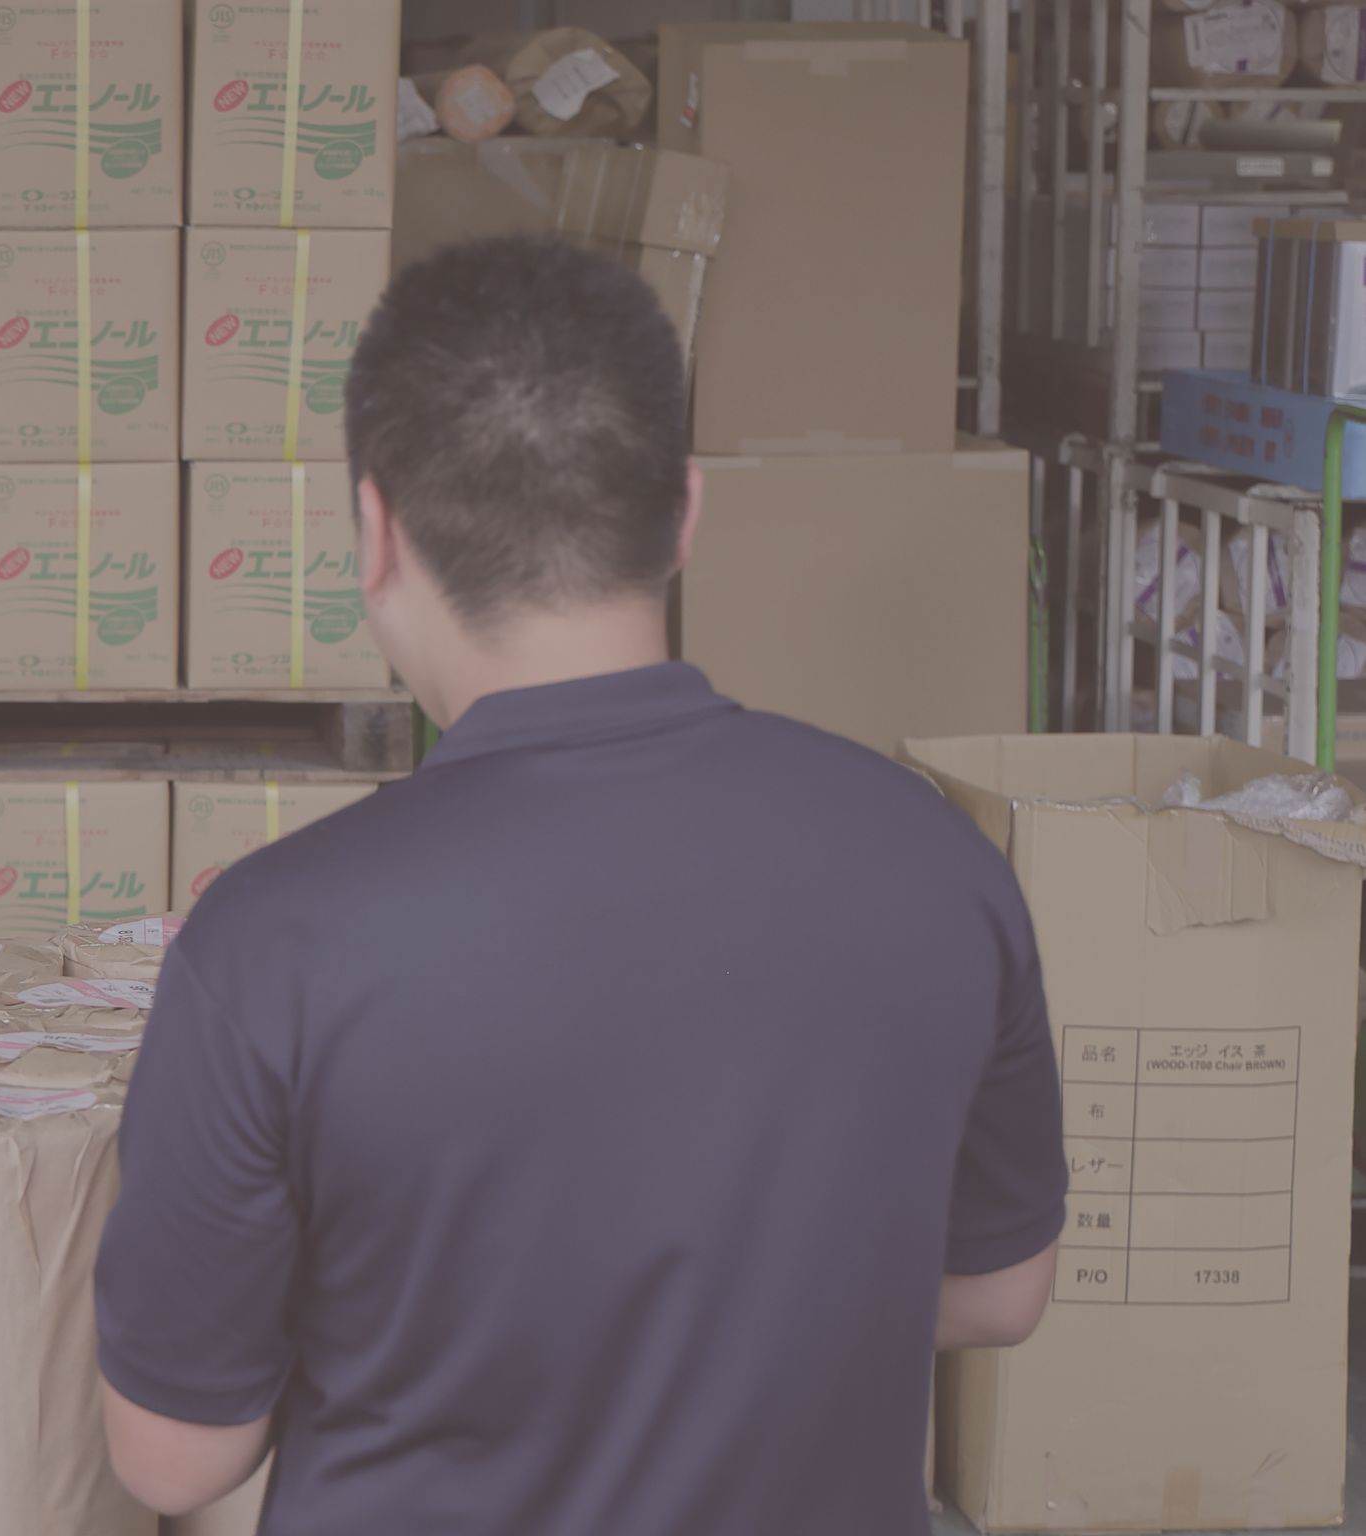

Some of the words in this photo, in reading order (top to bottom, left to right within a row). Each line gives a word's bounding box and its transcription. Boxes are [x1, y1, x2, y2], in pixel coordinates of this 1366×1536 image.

[216, 81, 247, 111] NEW
[19, 871, 146, 898] エコノール
[1081, 1044, 1116, 1062] 品名
[1170, 1044, 1209, 1058] エッジ
[1218, 1044, 1243, 1058] イス
[1215, 1060, 1243, 1072] Chair
[1245, 1059, 1286, 1072] BROWN)
[1071, 1156, 1125, 1174] レザー
[1077, 1212, 1111, 1229] 数量
[1076, 1269, 1108, 1284] P/O
[1194, 1269, 1241, 1285] 17338
